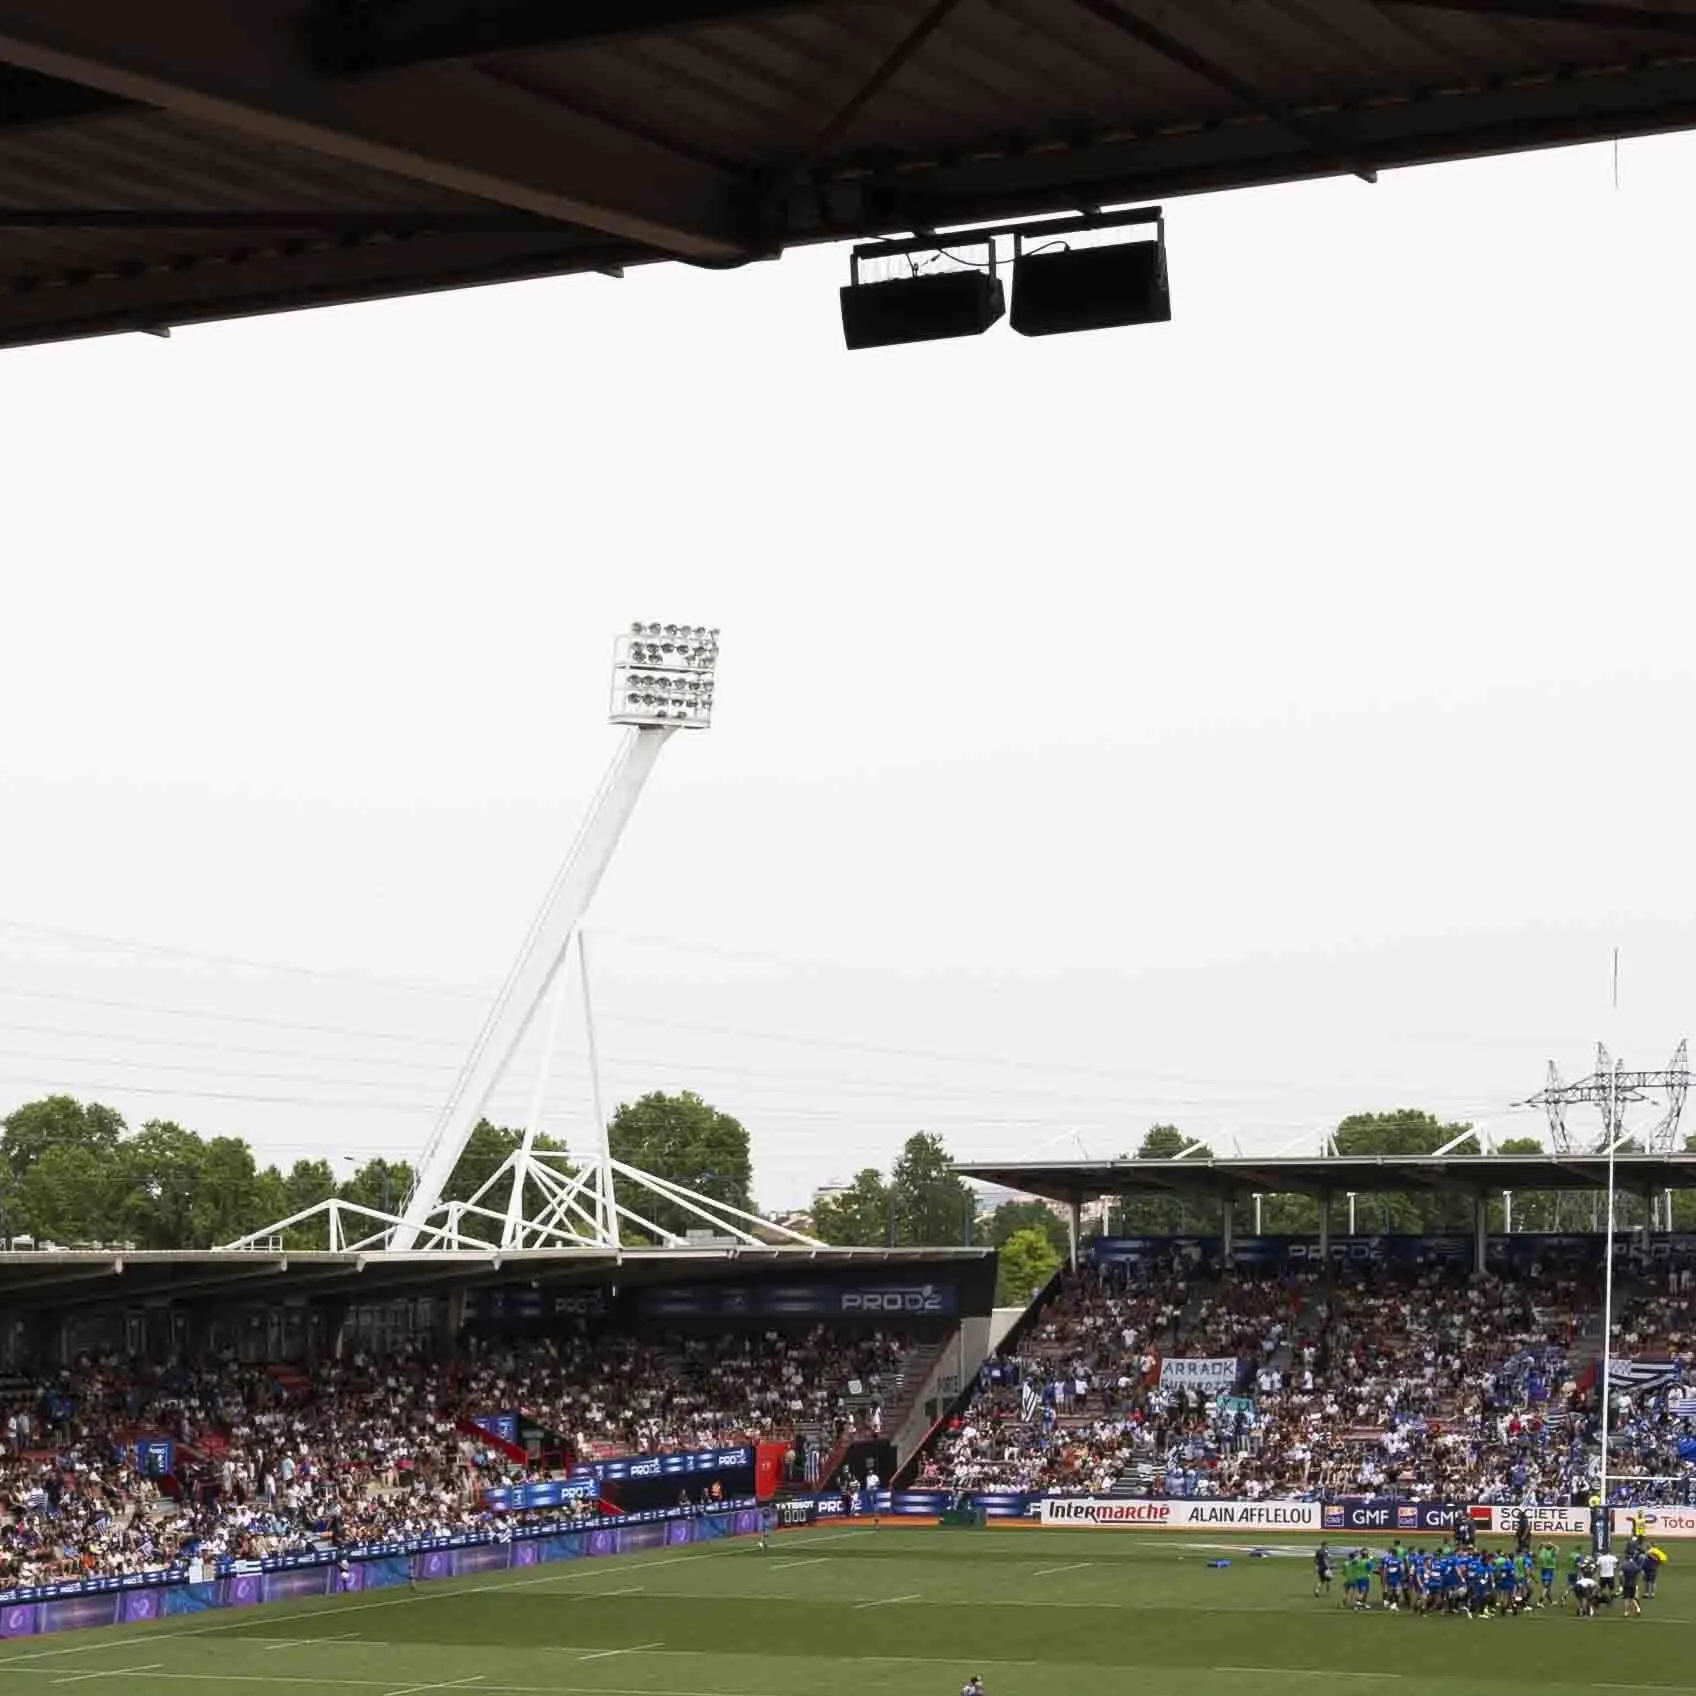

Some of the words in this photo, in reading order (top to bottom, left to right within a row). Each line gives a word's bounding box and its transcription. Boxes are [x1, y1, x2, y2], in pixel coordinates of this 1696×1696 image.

[842, 1293, 943, 1311] PROD2
[1048, 1501, 1170, 1522] Intermarché
[1189, 1503, 1235, 1522] ALAIN
[1238, 1504, 1312, 1524] AFFLELOU
[1353, 1509, 1389, 1525] GMF
[1426, 1511, 1457, 1526] GM
[1500, 1508, 1568, 1520] SOCIETE
